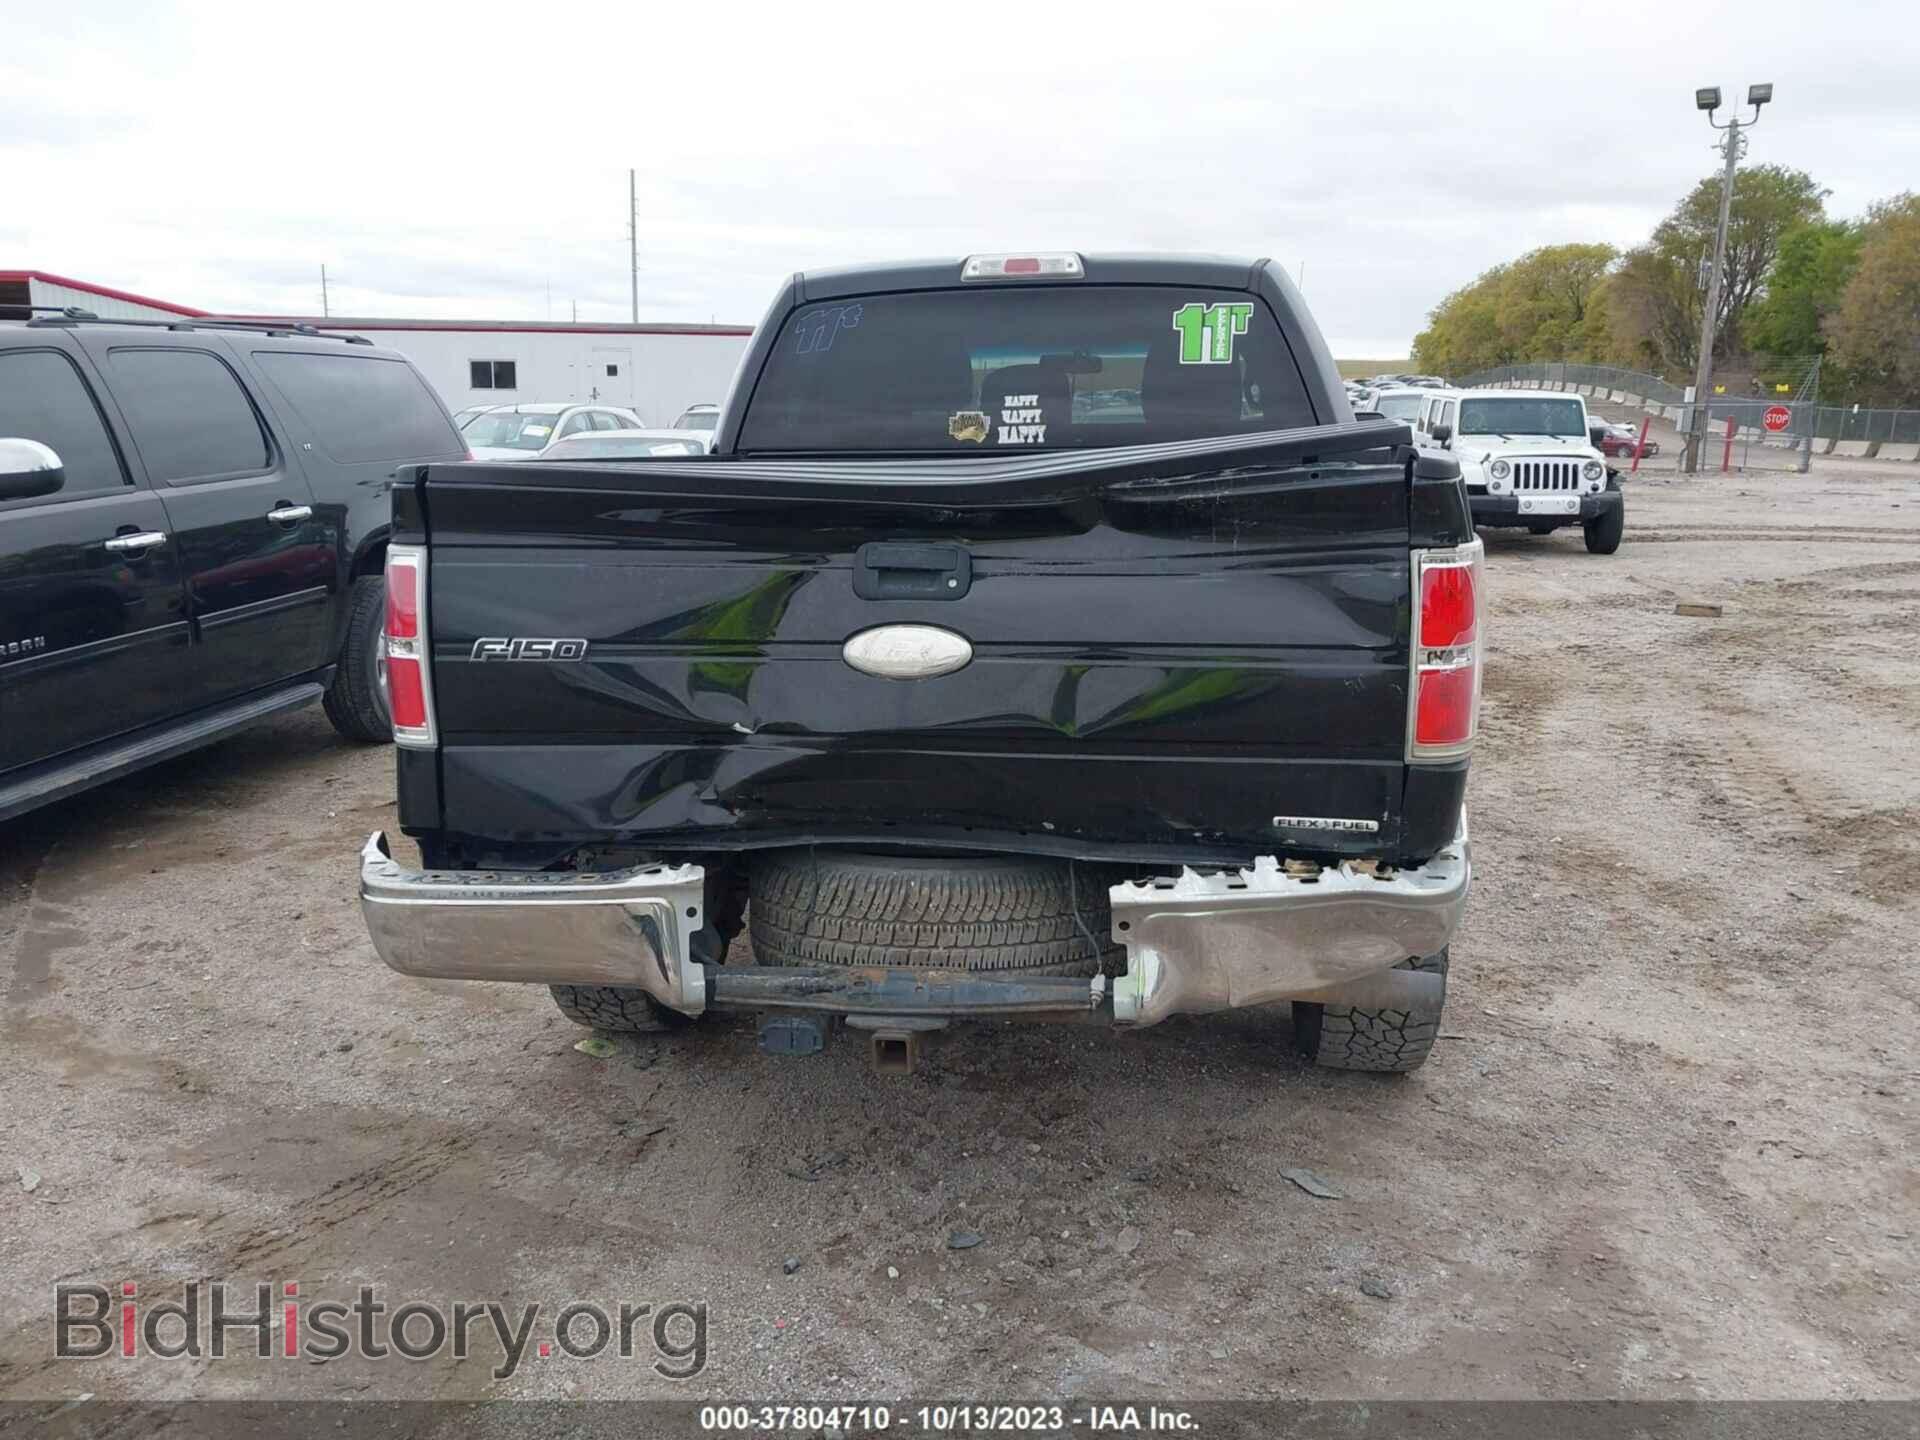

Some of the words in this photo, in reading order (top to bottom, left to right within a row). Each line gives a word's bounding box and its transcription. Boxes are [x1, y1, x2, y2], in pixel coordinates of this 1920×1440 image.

[1004, 395, 1039, 407] HAPPY
[1766, 413, 1789, 424] STOP
[998, 425, 1046, 444] HAPPY
[470, 638, 588, 662] F-150
[1277, 819, 1320, 829] FLEX
[1332, 821, 1375, 831] FUEL
